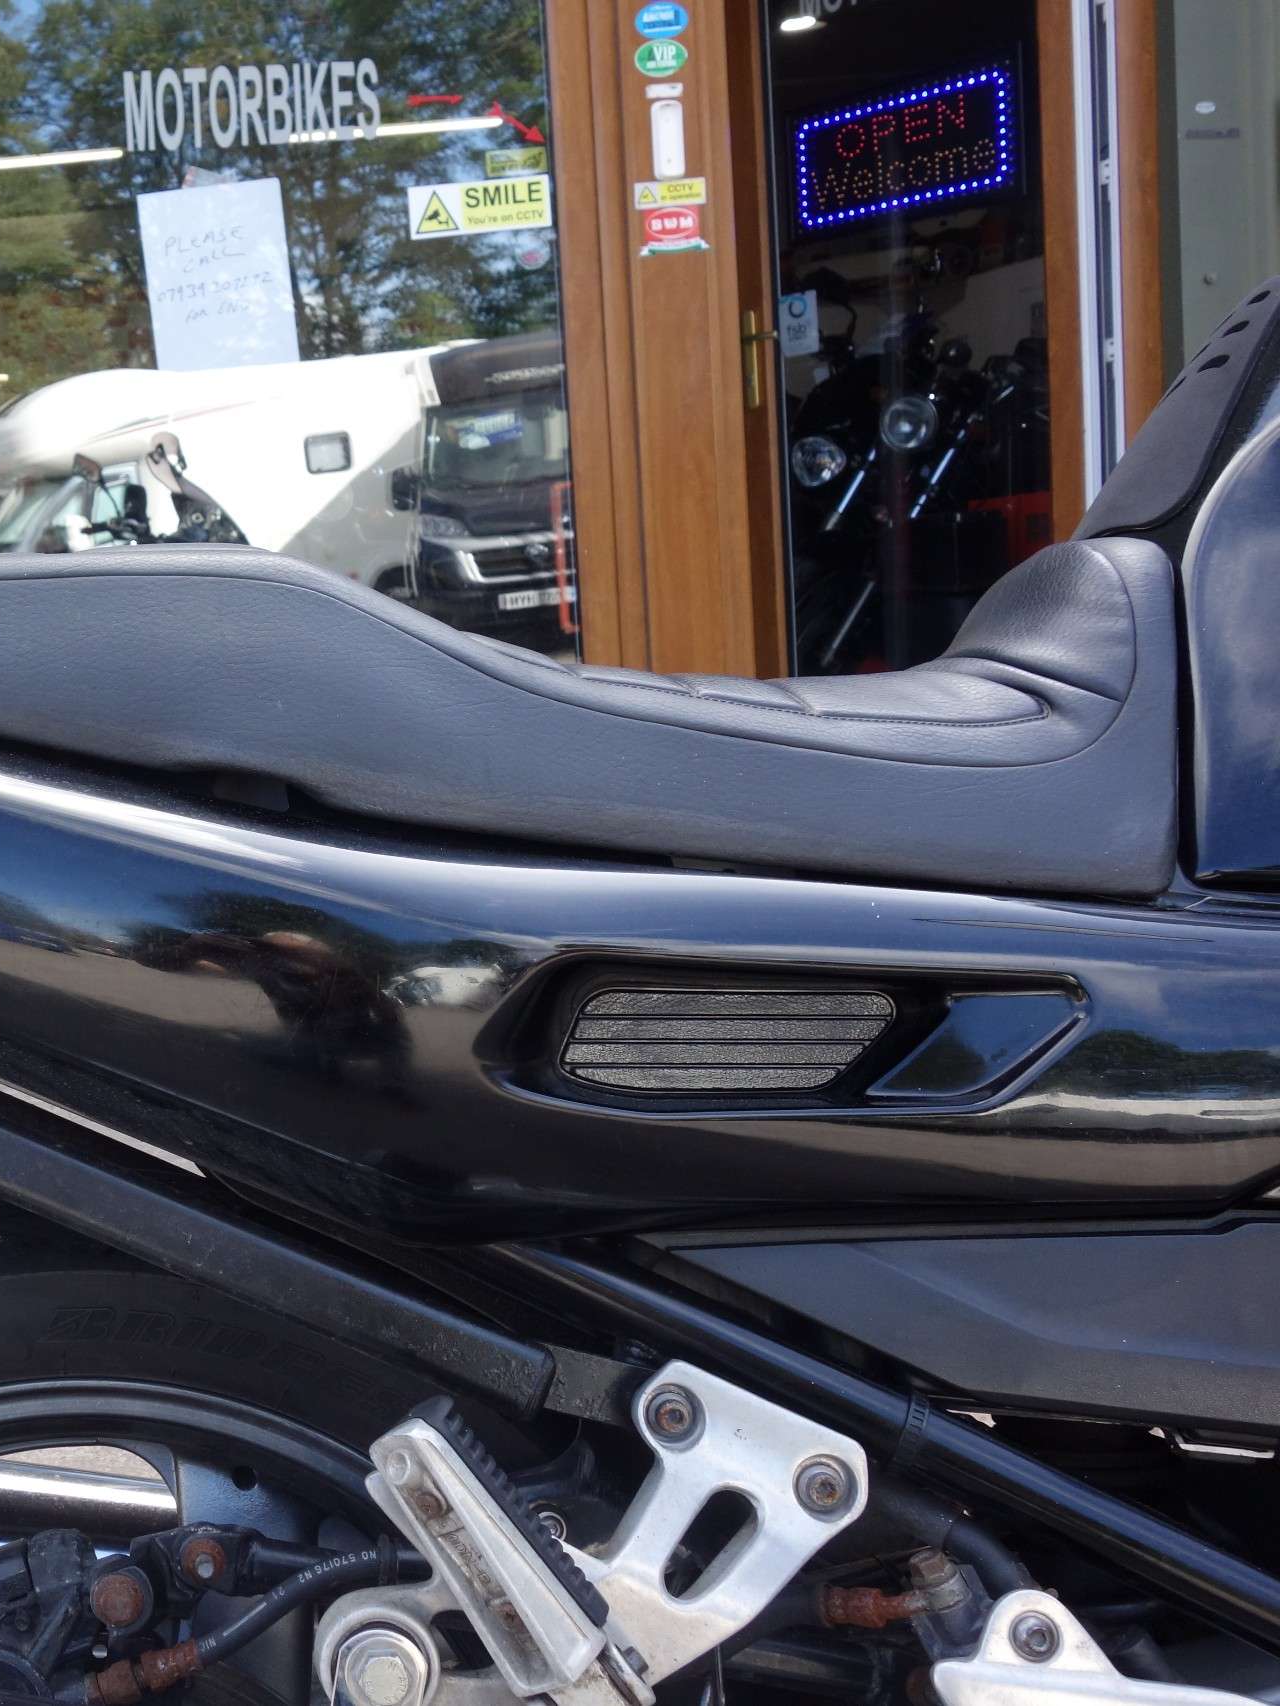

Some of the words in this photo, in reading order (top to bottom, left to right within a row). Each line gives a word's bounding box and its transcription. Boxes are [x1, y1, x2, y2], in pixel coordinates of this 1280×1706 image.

[652, 45, 677, 63] VIP
[123, 57, 381, 152] MOTORBIKES
[835, 93, 966, 159] OPEN
[667, 182, 694, 193] CCTV
[810, 138, 997, 210] Welcome
[465, 181, 543, 209] SMILE
[467, 214, 499, 226] You're
[500, 214, 514, 222] on
[516, 209, 544, 221] CCTV
[163, 226, 247, 258] PLEASE
